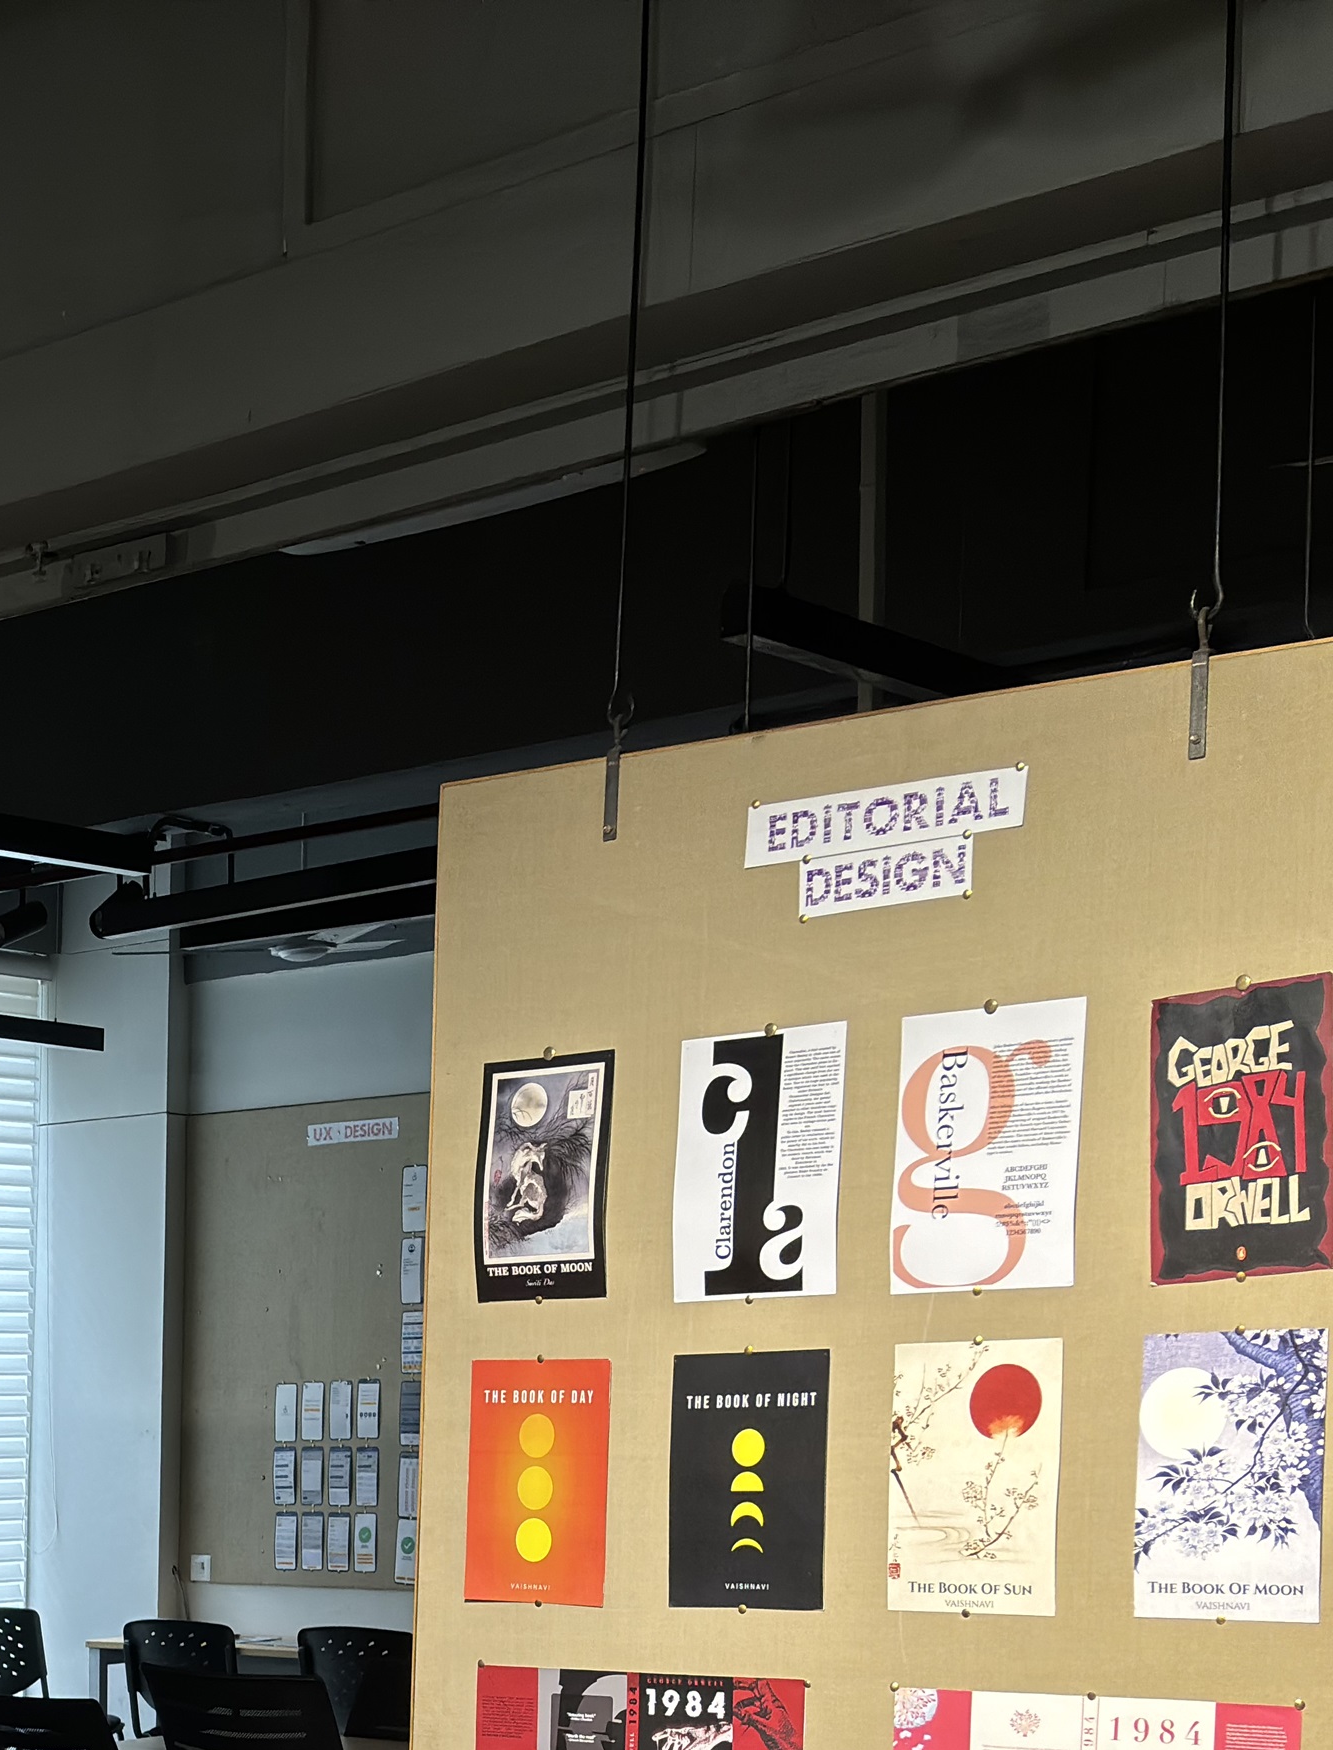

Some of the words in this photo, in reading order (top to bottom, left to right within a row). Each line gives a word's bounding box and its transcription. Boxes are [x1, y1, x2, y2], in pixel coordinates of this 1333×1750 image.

[1167, 1020, 1295, 1088] GEORGE
[313, 1125, 333, 1142] UX
[344, 1121, 393, 1139] DESIGN
[931, 1047, 970, 1220] Baskerville
[1171, 1069, 1309, 1186] 1984
[715, 1141, 738, 1260] Clarendon
[1185, 1174, 1311, 1231] ORWELL
[487, 1267, 509, 1277] THE
[512, 1265, 541, 1276] BOOK
[544, 1264, 558, 1274] OF
[561, 1262, 593, 1273] MOON
[484, 1389, 507, 1404] THE
[513, 1389, 545, 1404] BOOK
[550, 1389, 566, 1404] OF
[571, 1389, 595, 1405] DAY
[686, 1395, 710, 1410] THE
[716, 1394, 749, 1409] BOOK
[755, 1393, 771, 1408] OF
[777, 1392, 818, 1408] NIGHT
[510, 1582, 551, 1591] VAISHNAVI
[724, 1582, 770, 1591] VAISHNAVI
[908, 1580, 935, 1594] THE
[938, 1582, 978, 1595] BOOK
[1003, 1583, 1033, 1596] SUN
[1147, 1580, 1178, 1595] THE
[1181, 1582, 1225, 1595] BOOK
[1254, 1582, 1304, 1597] MOON
[944, 1599, 994, 1609] VAISHNAVI
[1195, 1600, 1251, 1611] VAISHNAVI
[629, 1687, 638, 1725] 1984
[645, 1687, 726, 1719] 1984
[1109, 1714, 1202, 1746] 1984
